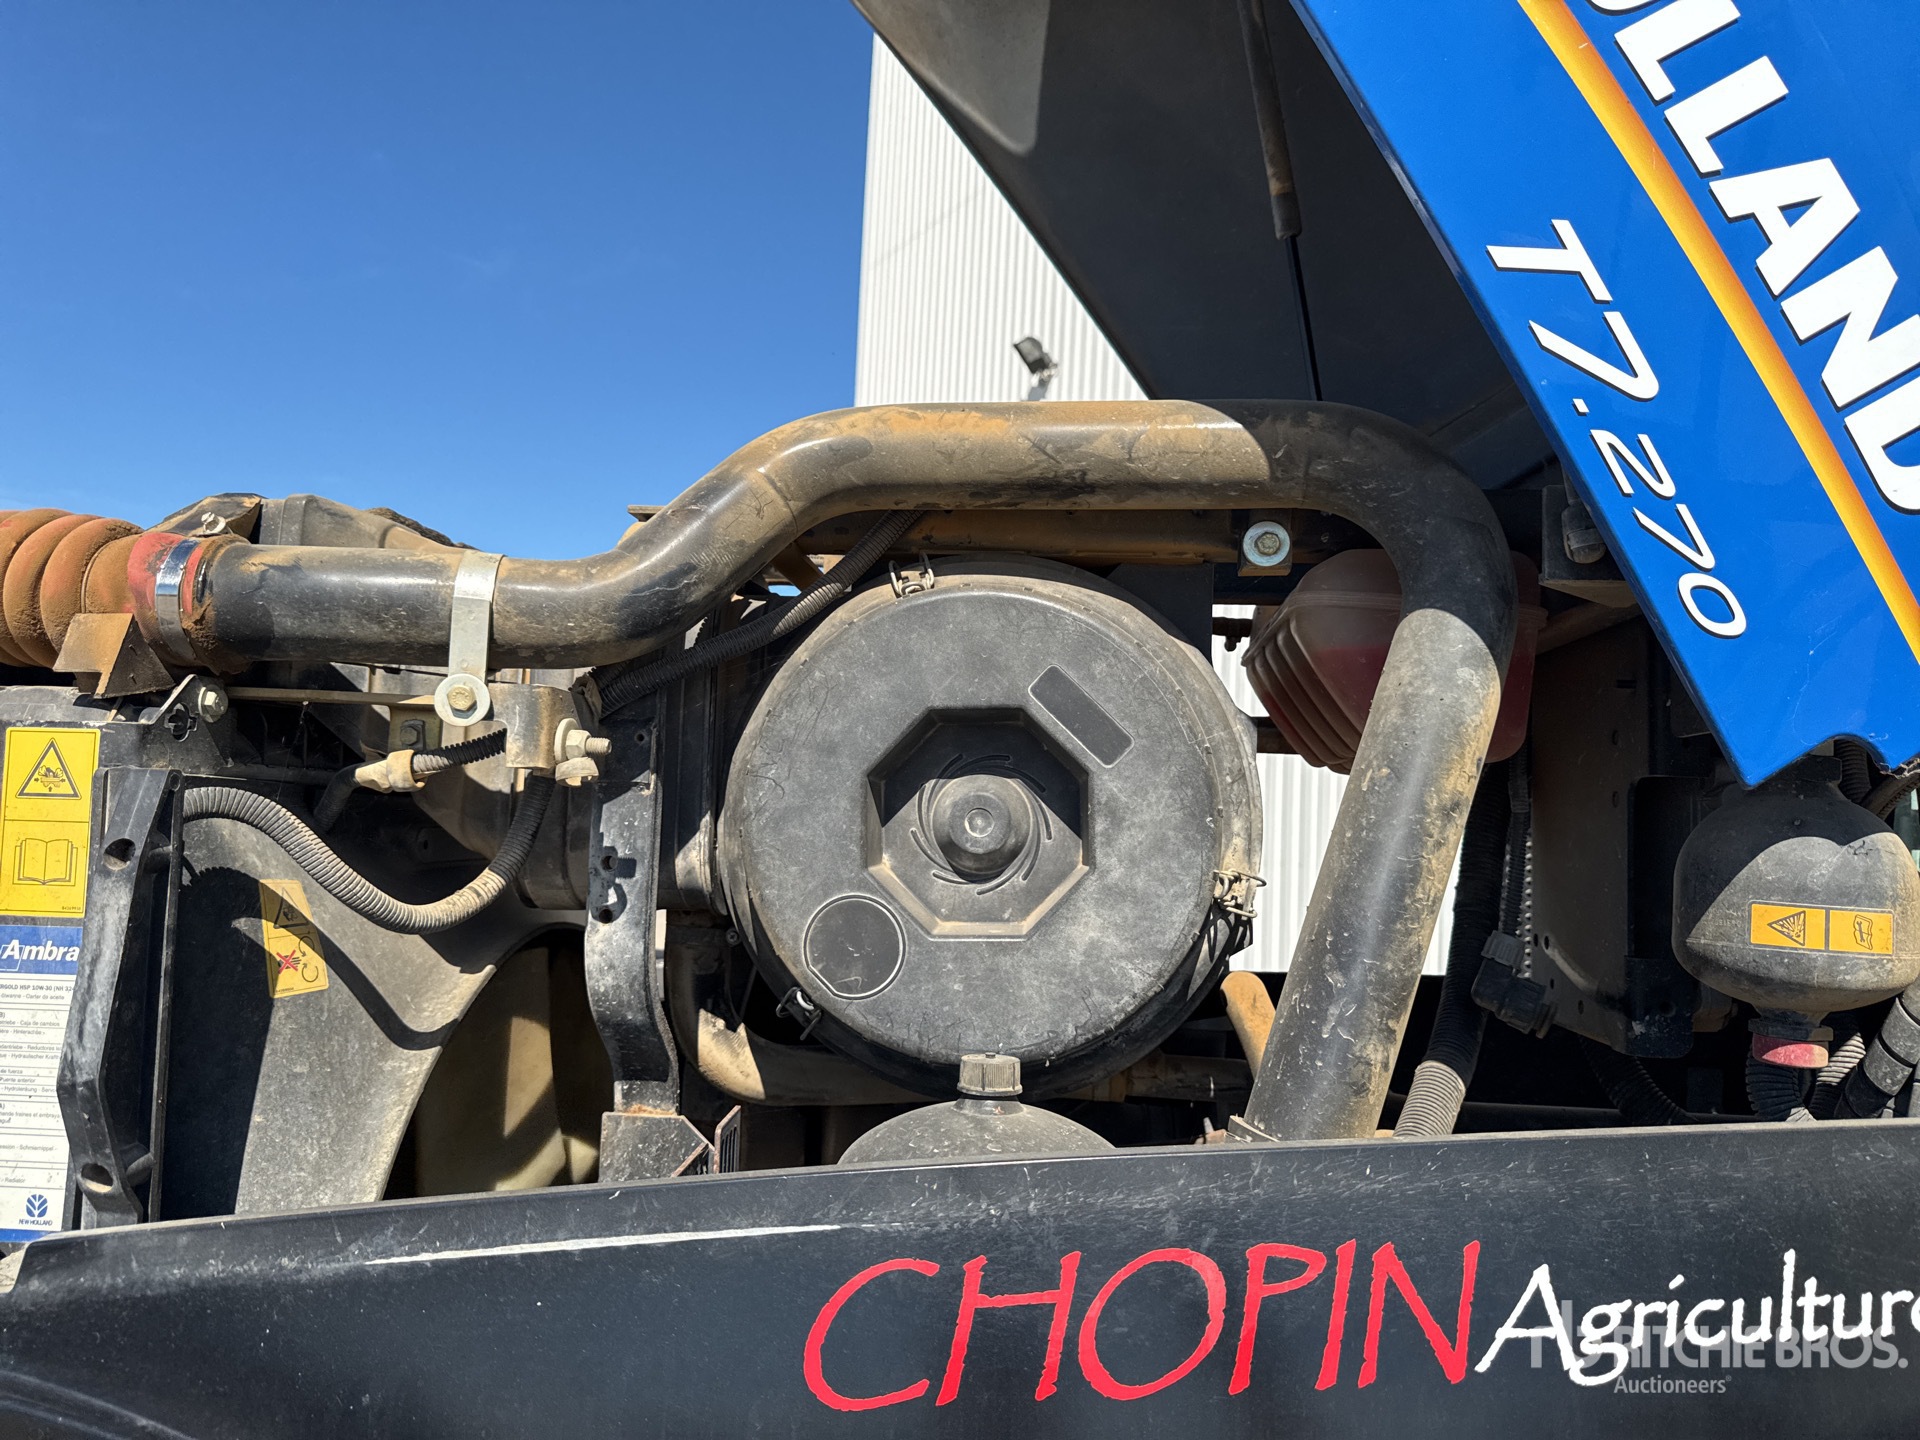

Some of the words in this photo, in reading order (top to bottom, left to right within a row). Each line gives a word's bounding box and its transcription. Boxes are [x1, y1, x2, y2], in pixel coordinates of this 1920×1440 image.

[1590, 0, 1920, 512] LLAND
[1485, 218, 1748, 639] T7.270
[1, 939, 80, 962] Ambra
[803, 1239, 1481, 1412] CHOPIN
[1474, 1248, 1920, 1386] Agricultur
